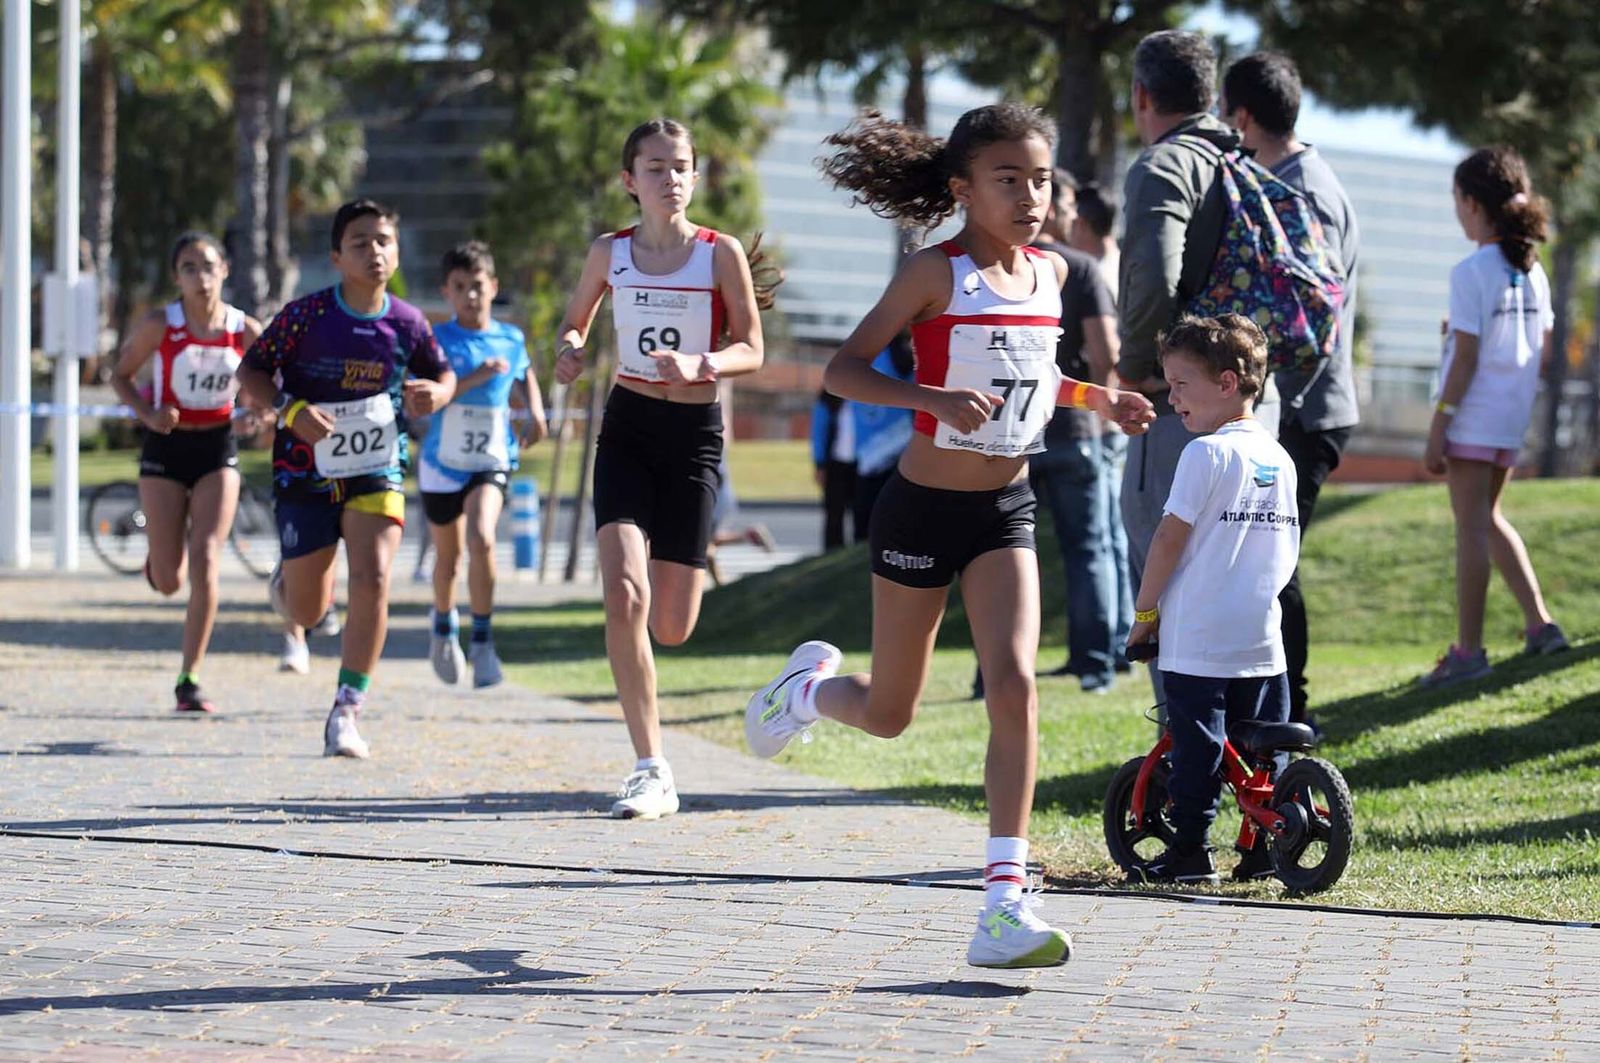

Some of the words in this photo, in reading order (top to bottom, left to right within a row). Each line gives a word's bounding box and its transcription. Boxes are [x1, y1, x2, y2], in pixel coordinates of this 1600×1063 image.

[638, 326, 681, 356] 69
[990, 331, 1007, 346] H
[188, 373, 231, 391] 148
[991, 378, 1039, 422] 77
[331, 427, 385, 457] 202
[461, 431, 489, 454] 32
[1219, 509, 1265, 523] ATLANTIC
[1267, 511, 1298, 527] COPPE
[882, 549, 935, 570] CURTIUS
